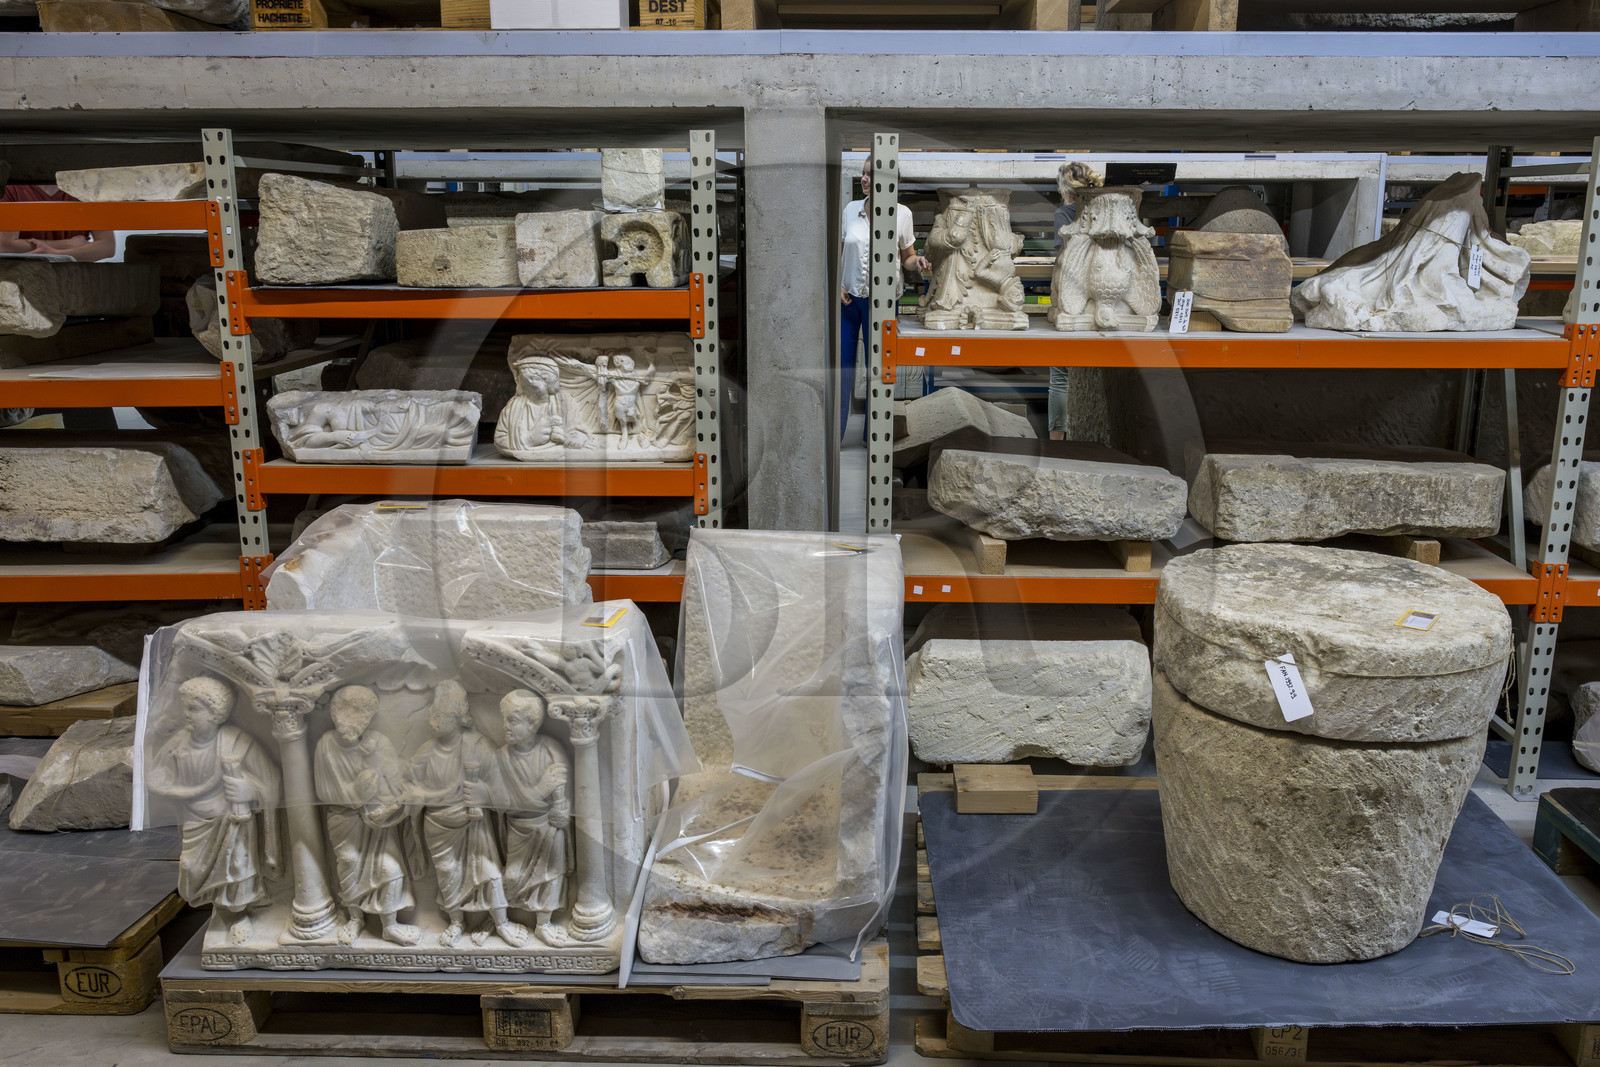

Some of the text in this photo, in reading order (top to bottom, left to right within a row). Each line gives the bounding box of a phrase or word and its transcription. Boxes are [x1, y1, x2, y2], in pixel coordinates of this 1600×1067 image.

[648, 0, 687, 13] DEST
[258, 13, 303, 23] HACHETTE
[76, 972, 111, 993] EUR
[825, 1025, 863, 1050] EUR
